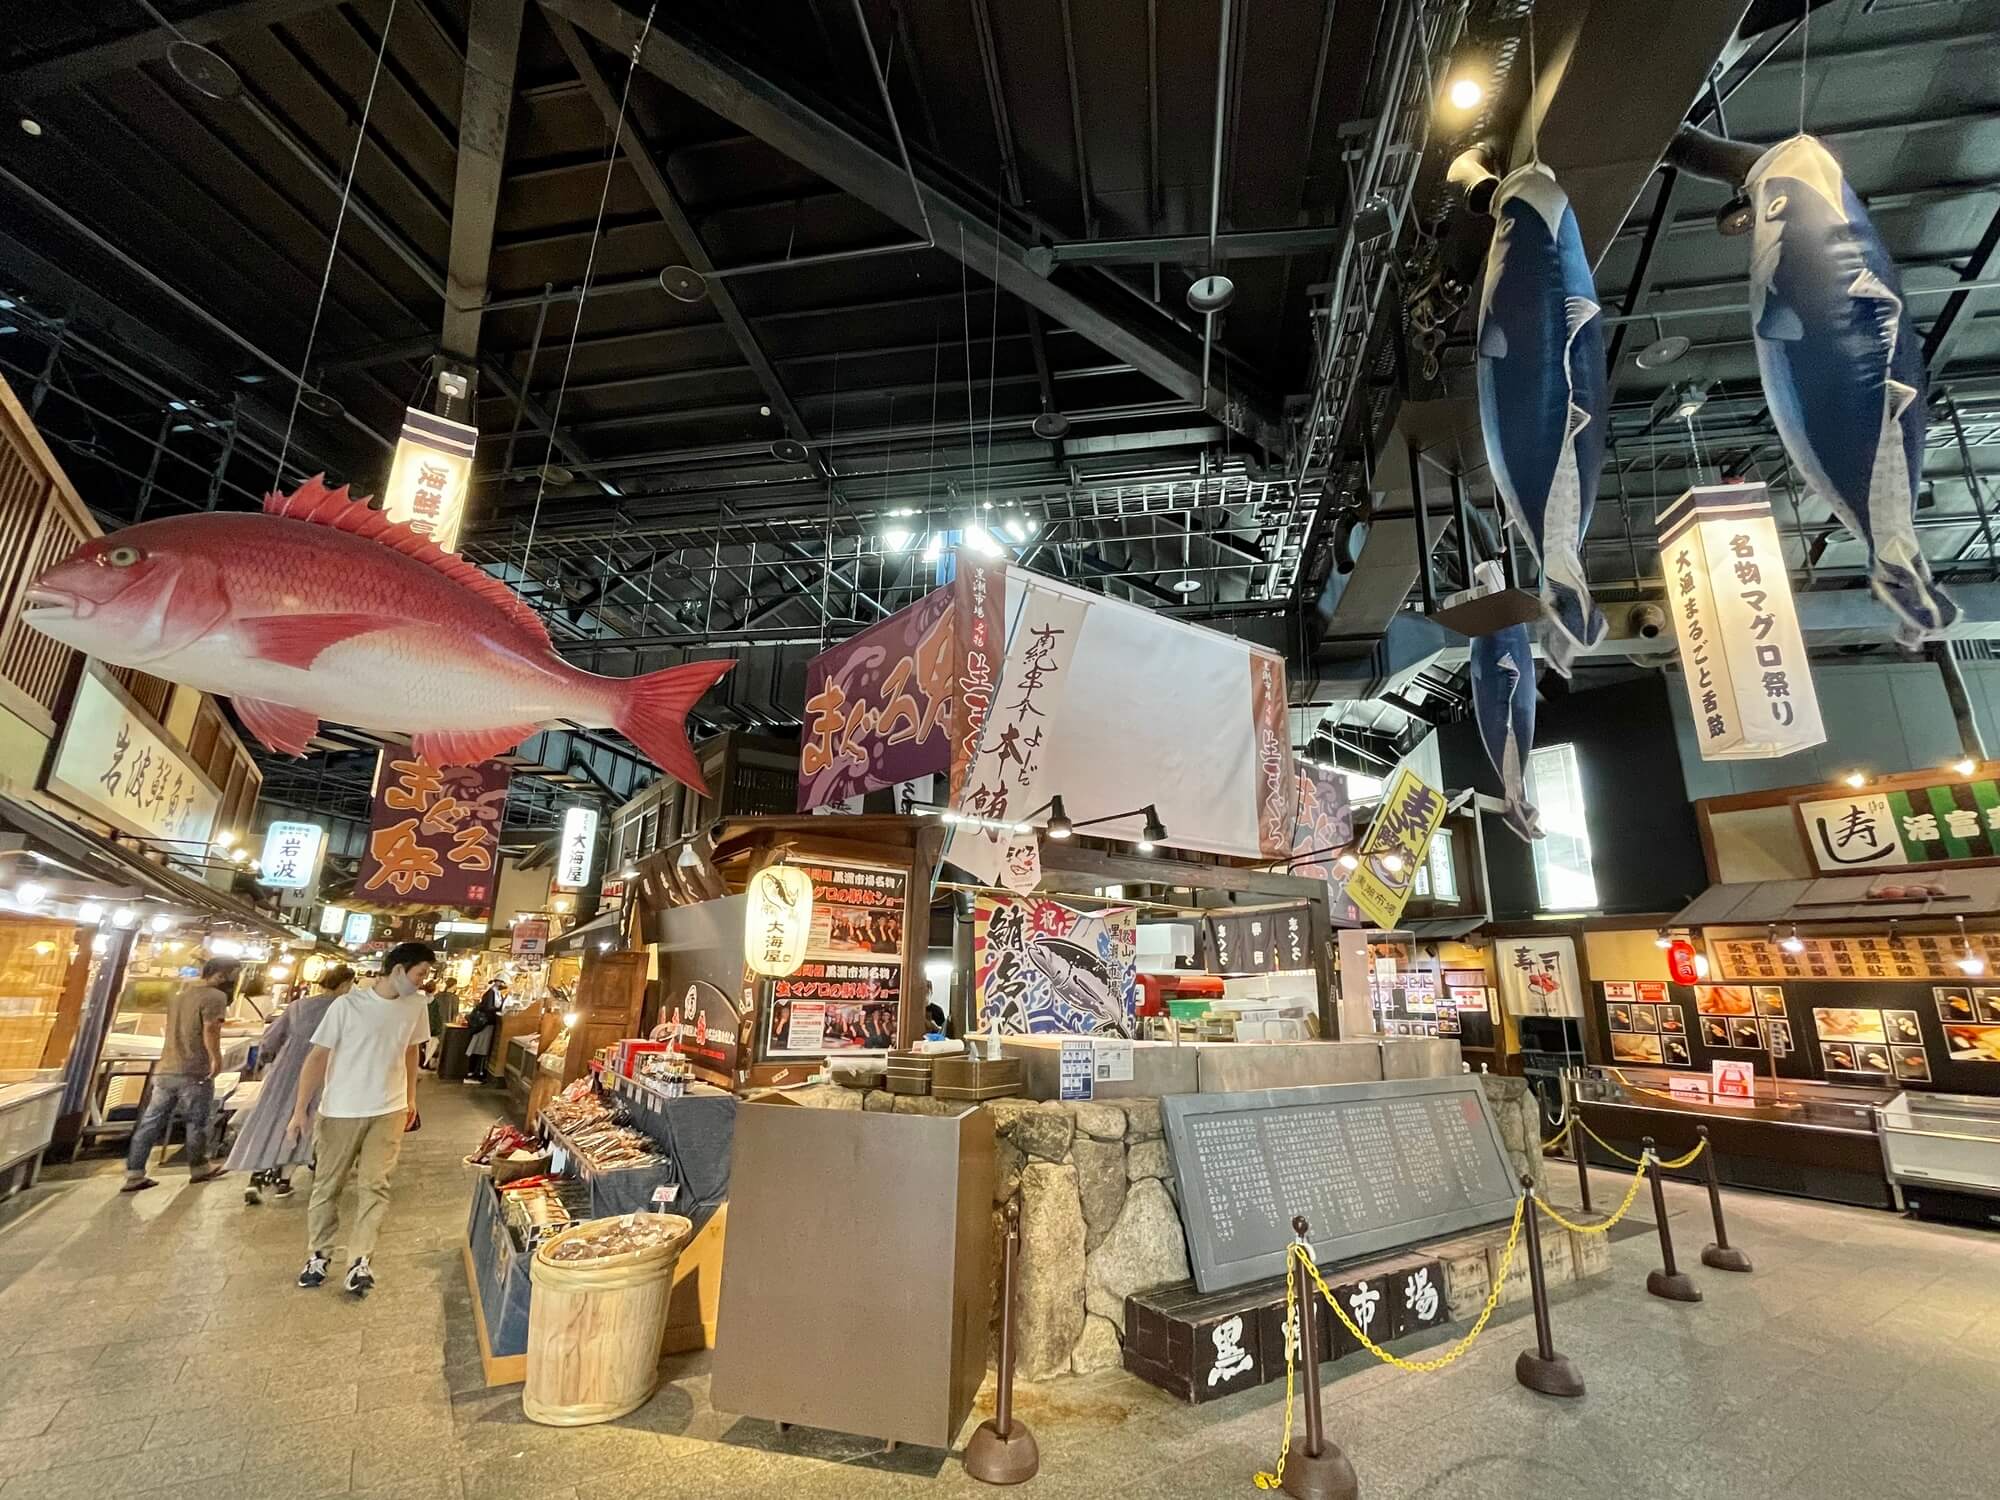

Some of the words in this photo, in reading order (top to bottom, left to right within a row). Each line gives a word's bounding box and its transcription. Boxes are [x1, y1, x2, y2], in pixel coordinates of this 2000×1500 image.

[1675, 549, 1727, 738] 大漁まるごと舌鼓
[1729, 534, 1793, 727] 名物マグロ祭り
[385, 755, 491, 871] まぐろ
[273, 838, 301, 878] 岩波
[365, 818, 444, 894] 祭
[566, 833, 587, 882] 大海屋
[763, 920, 785, 963] 大海屋
[1039, 907, 1057, 931] 祝
[1513, 945, 1560, 973] 寿司
